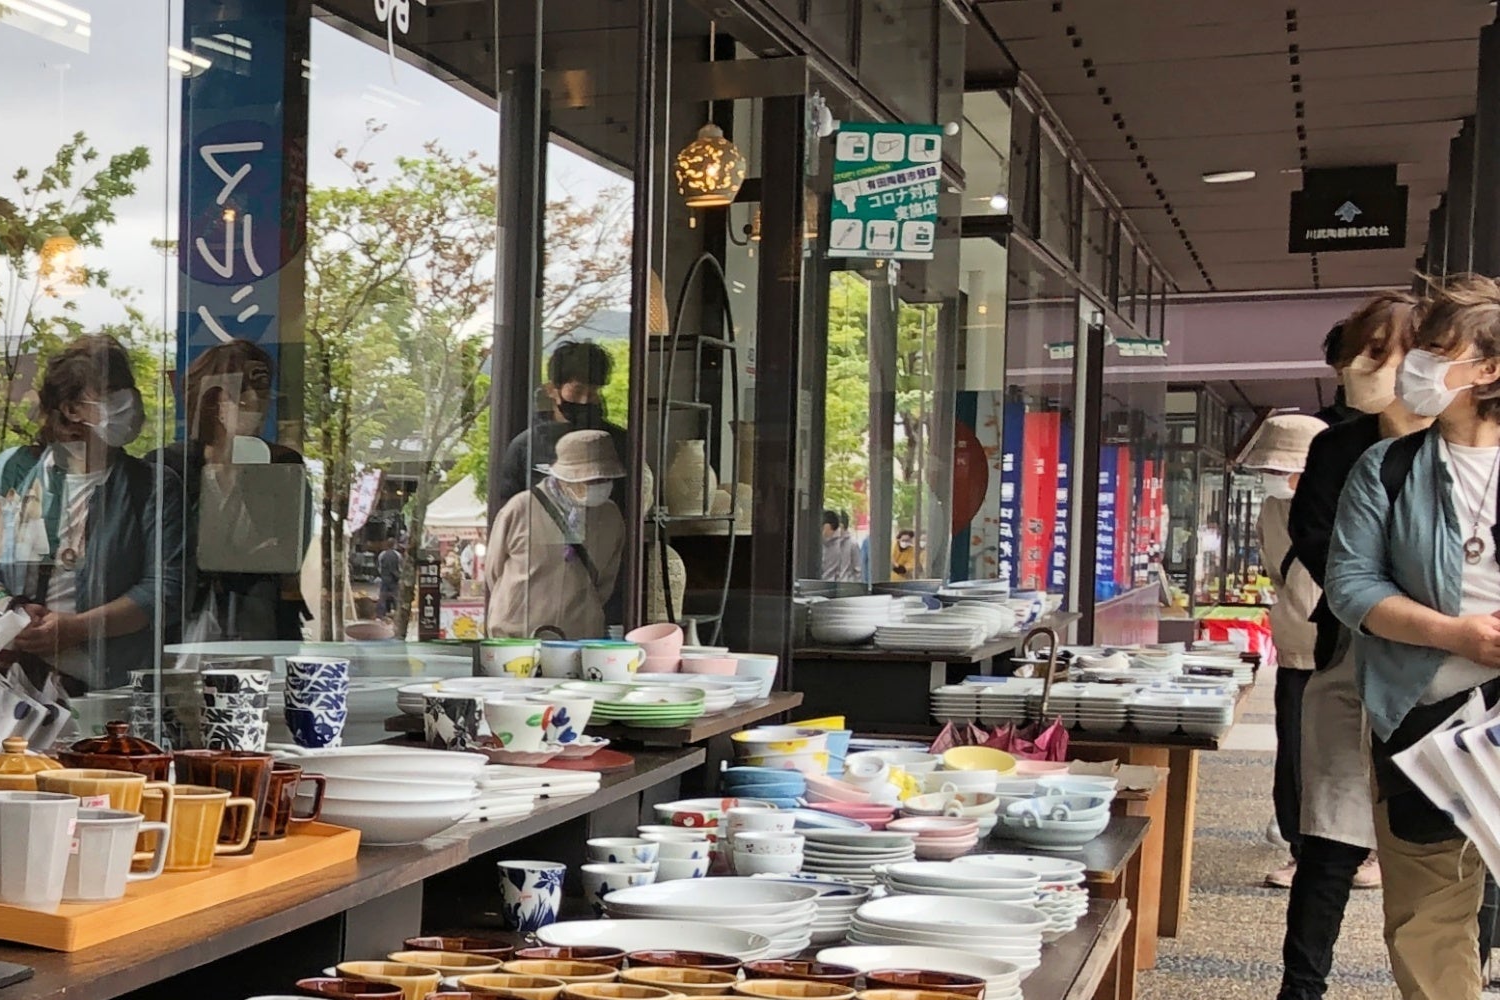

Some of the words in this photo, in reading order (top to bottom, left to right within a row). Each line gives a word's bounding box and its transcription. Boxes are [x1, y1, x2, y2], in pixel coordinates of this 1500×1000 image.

[868, 182, 938, 209] コロナ対策
[894, 200, 938, 221] 実施店
